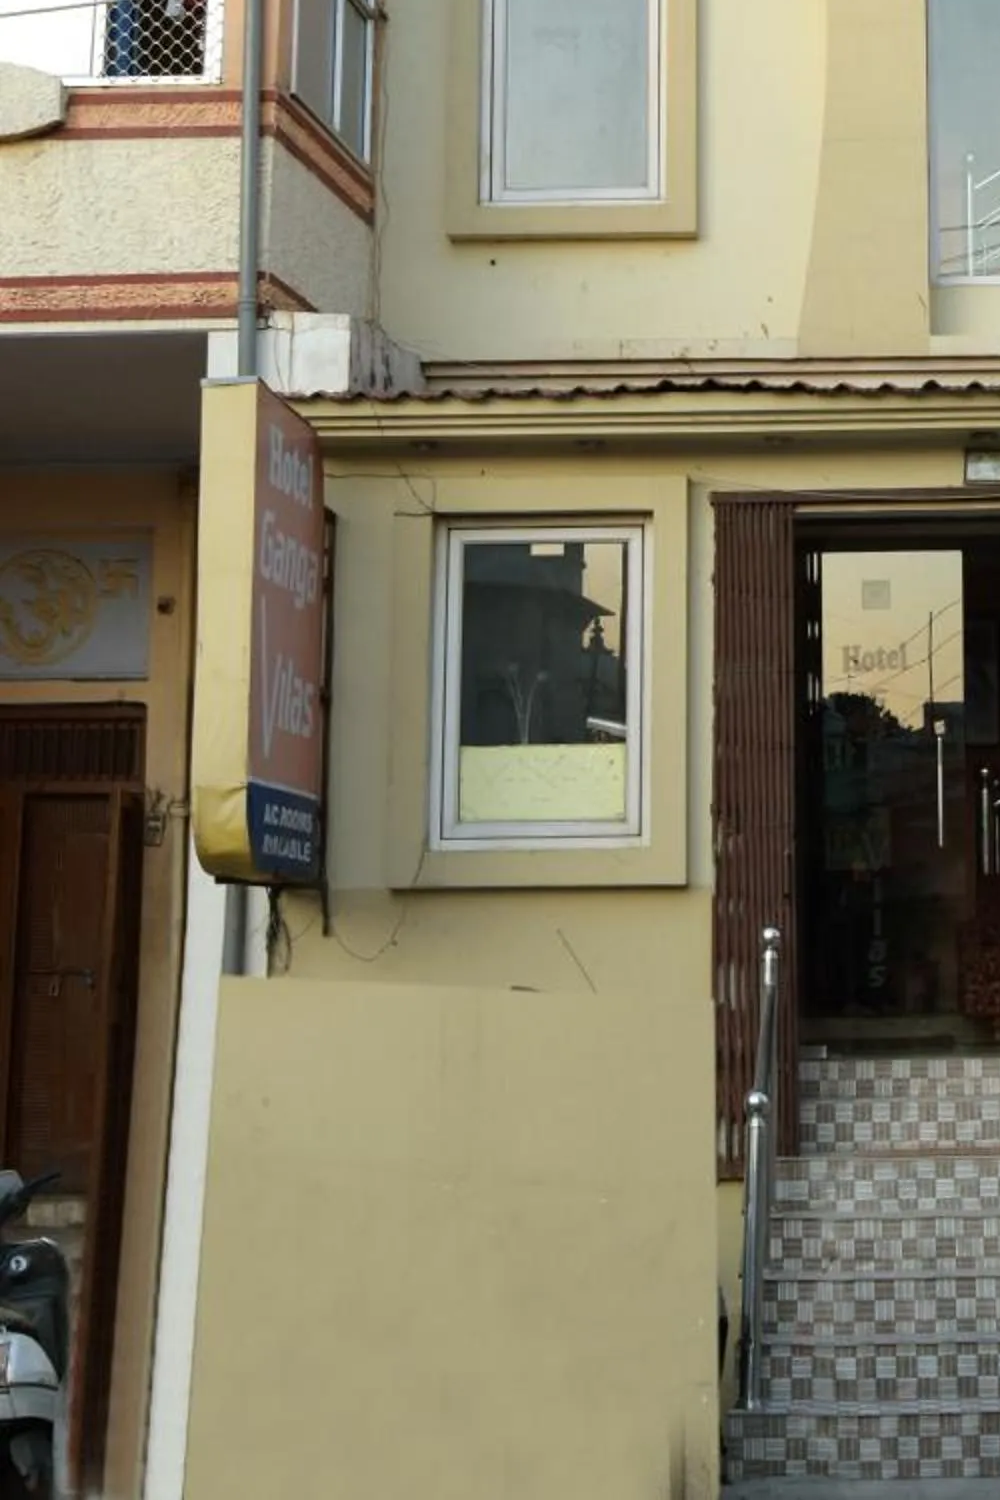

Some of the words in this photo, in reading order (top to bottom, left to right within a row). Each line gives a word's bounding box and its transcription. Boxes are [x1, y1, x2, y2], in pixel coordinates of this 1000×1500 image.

[269, 423, 315, 510] Hotel
[260, 509, 318, 609] Ganga
[262, 593, 313, 758] Vilas
[842, 643, 907, 673] Hotel
[263, 803, 279, 825] AC
